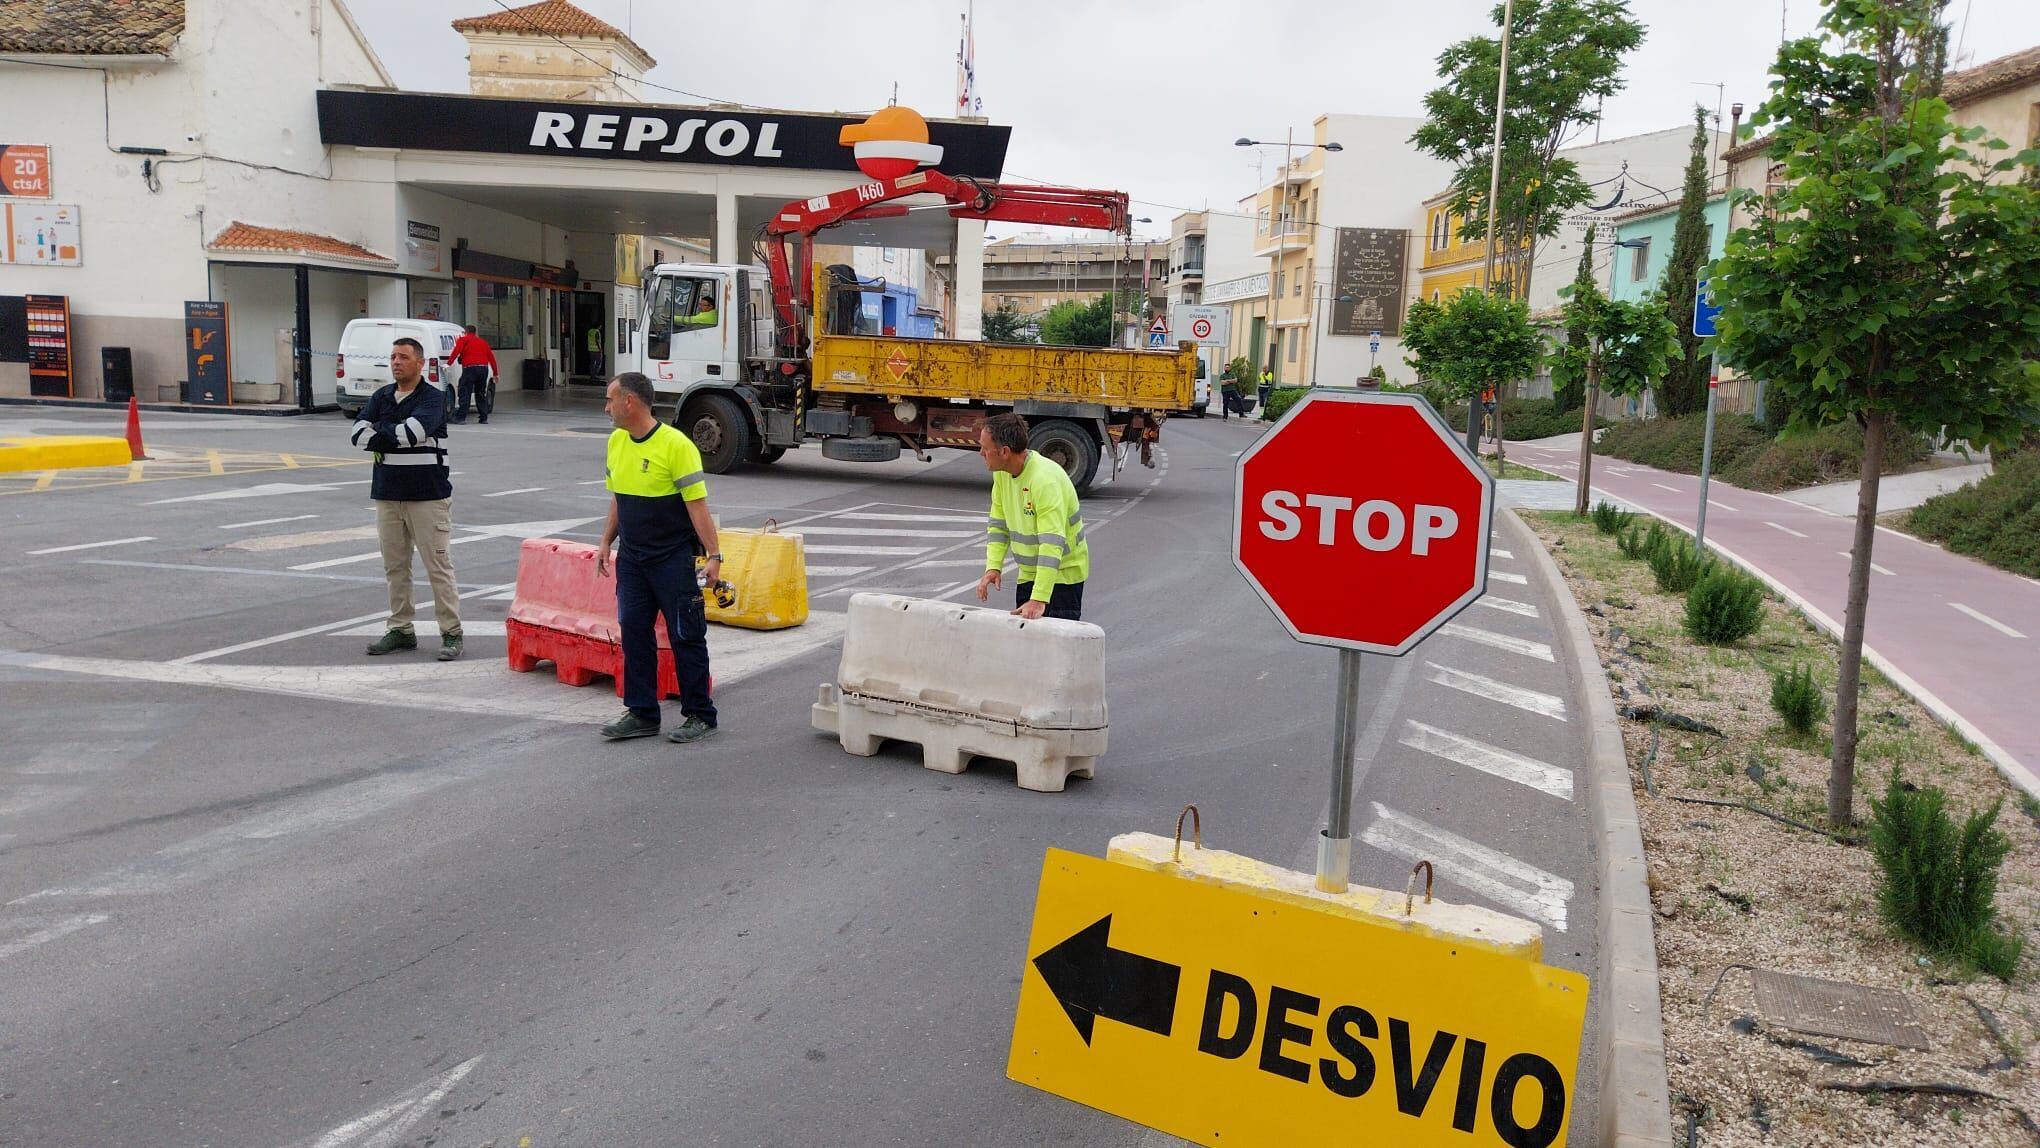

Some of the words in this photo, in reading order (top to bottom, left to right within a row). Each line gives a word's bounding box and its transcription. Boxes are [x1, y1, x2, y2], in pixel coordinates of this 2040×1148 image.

[529, 111, 782, 158] REPSOL
[15, 159, 37, 175] 20
[13, 178, 42, 190] cts/l
[856, 182, 885, 202] 1460
[1258, 490, 1459, 556] STOP
[1197, 968, 1566, 1148] DESVIO
